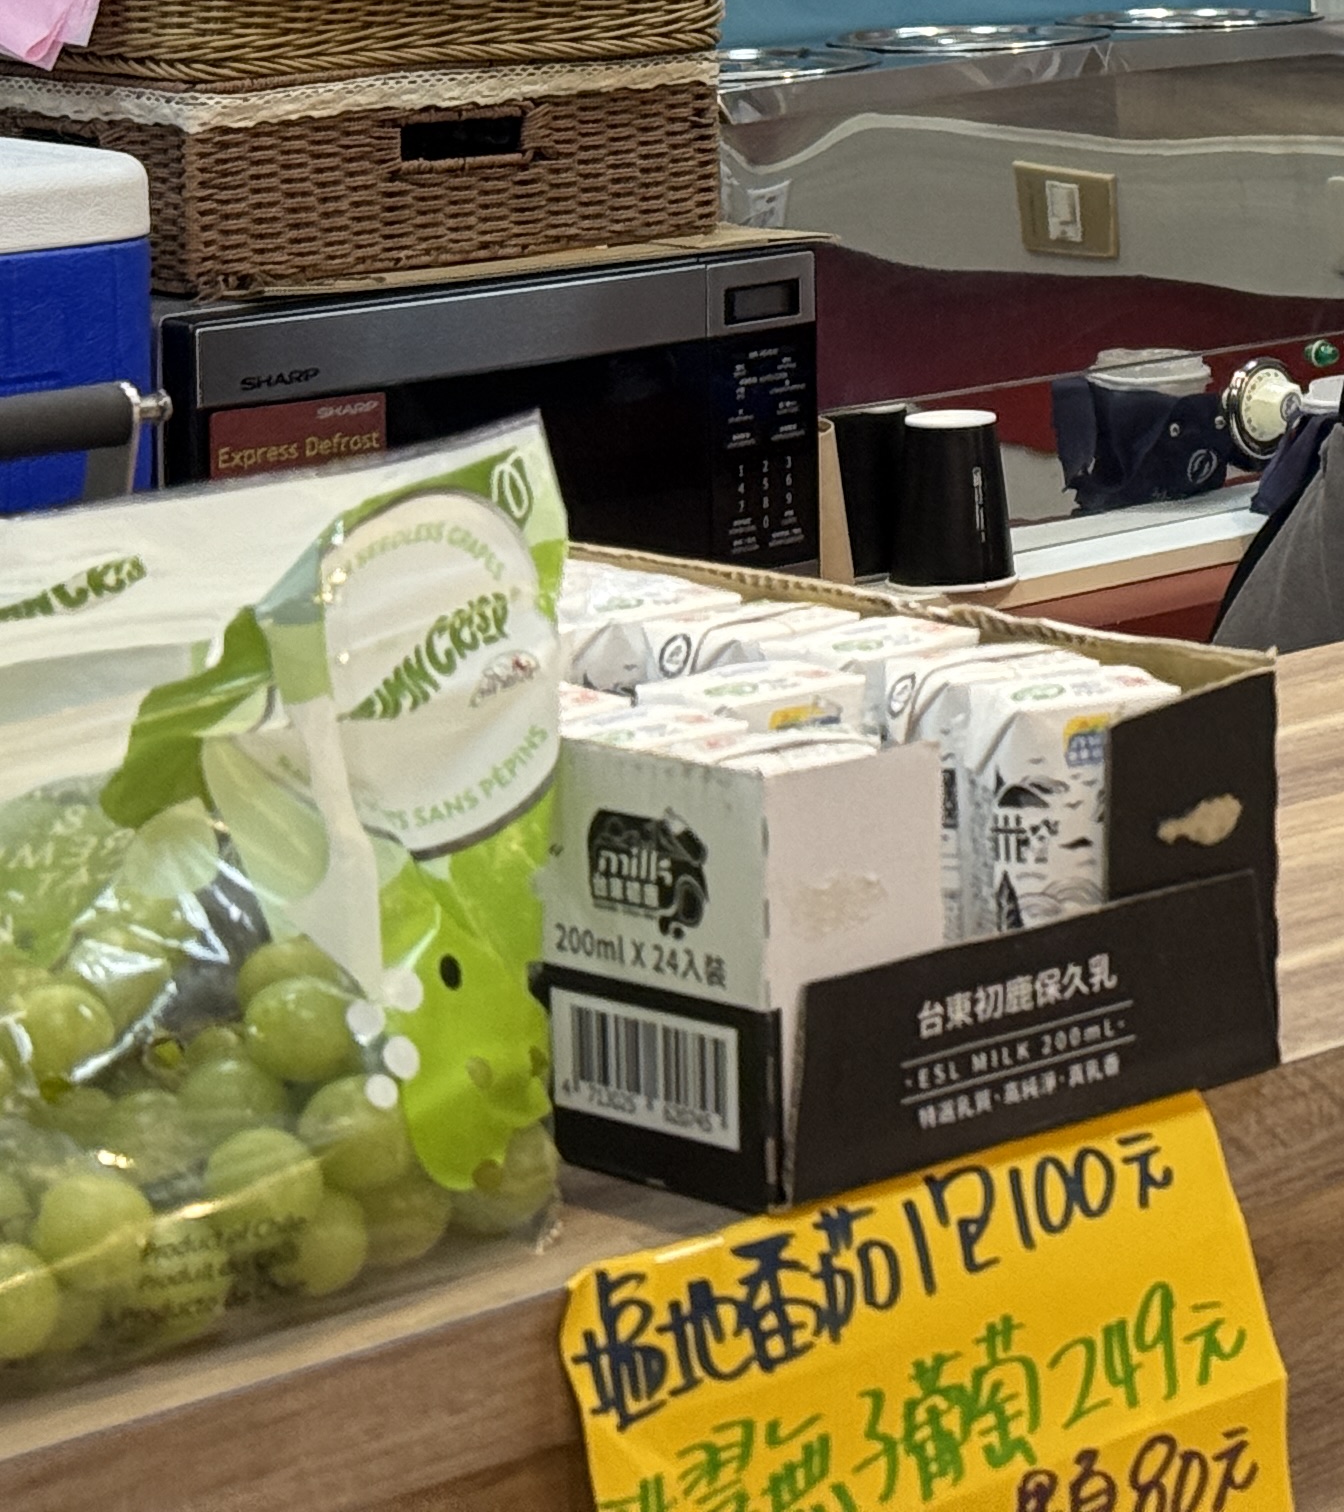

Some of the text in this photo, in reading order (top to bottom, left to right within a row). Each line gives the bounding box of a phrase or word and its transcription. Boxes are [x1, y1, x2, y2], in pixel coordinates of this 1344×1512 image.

[240, 367, 320, 391] SHARP
[316, 400, 380, 420] SHARP
[217, 430, 380, 470] Express Defrost
[412, 789, 480, 829] SANS
[971, 1041, 1031, 1073] MILK
